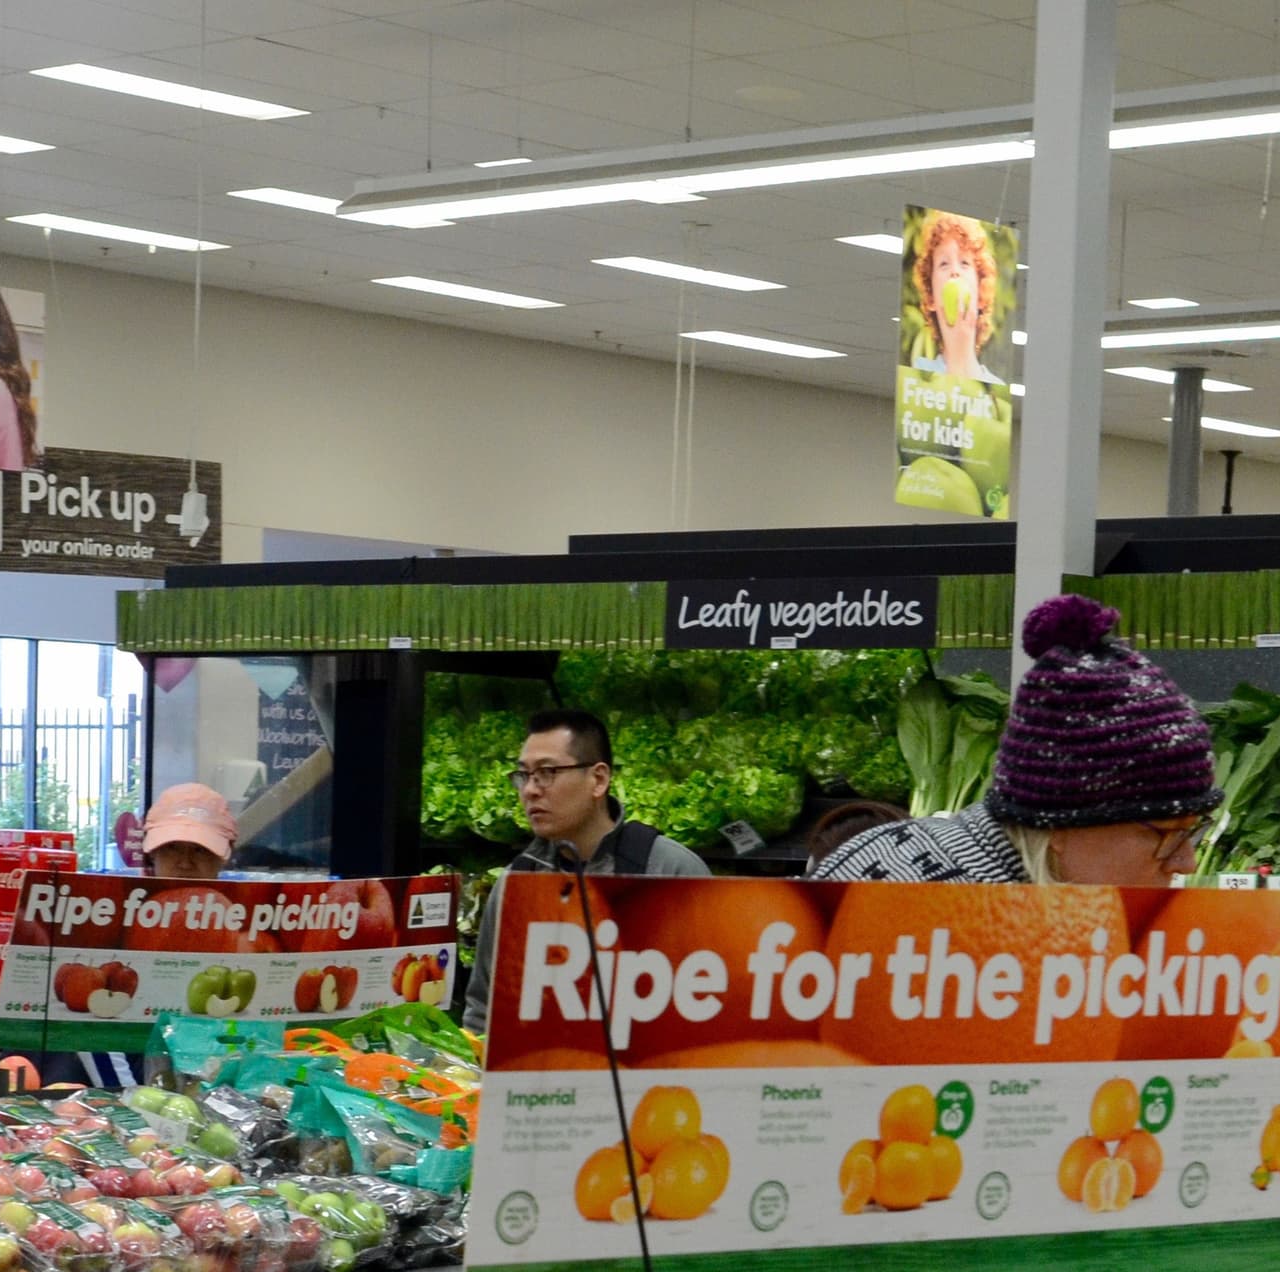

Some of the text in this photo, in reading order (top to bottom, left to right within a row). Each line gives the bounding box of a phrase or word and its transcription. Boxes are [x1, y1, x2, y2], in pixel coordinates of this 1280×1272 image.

[903, 377, 993, 418] Free fruit
[902, 410, 974, 449] for kids
[20, 470, 156, 533] Pick up
[21, 538, 155, 560] your online order
[678, 588, 923, 646] Leafy vegetables
[24, 883, 361, 941] Ripe for the picking
[518, 918, 728, 1050] Ripe
[747, 920, 872, 1020] for
[886, 927, 1024, 1020] the
[506, 1089, 577, 1111] Imperial
[761, 1083, 823, 1101] Phoenix
